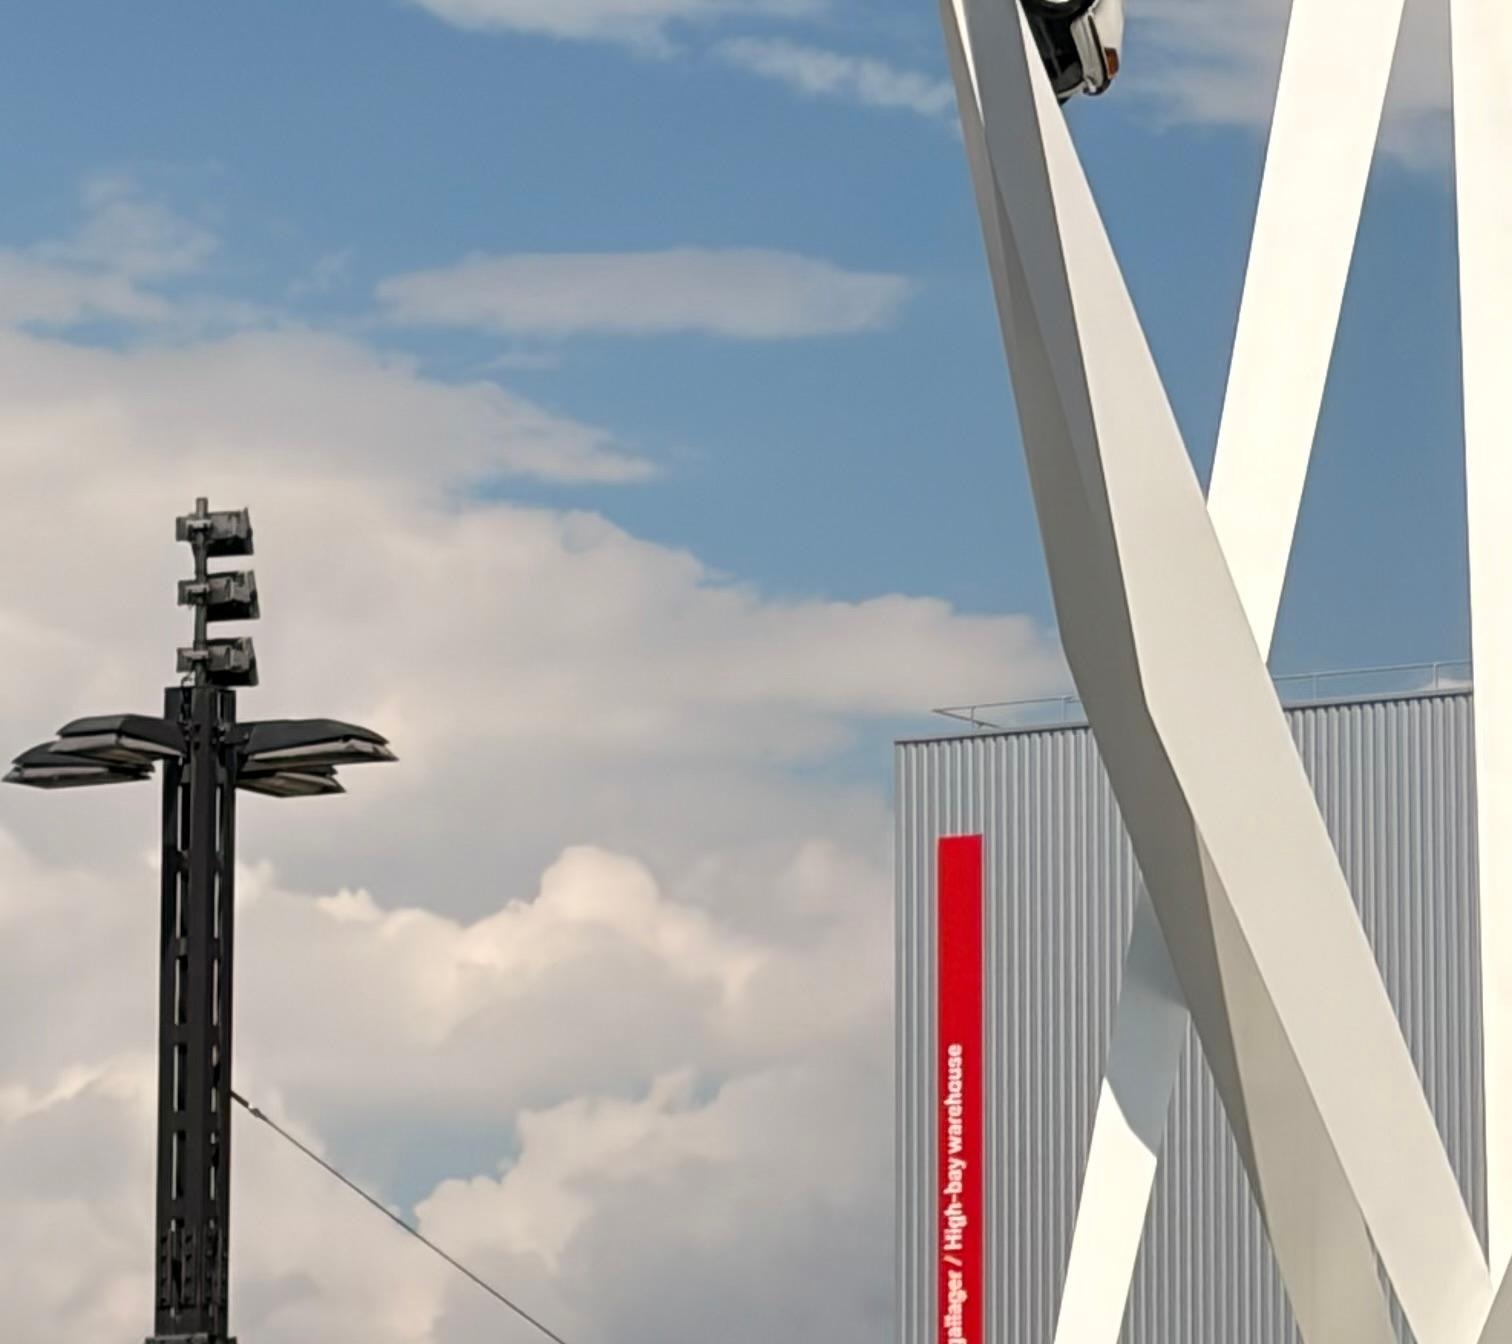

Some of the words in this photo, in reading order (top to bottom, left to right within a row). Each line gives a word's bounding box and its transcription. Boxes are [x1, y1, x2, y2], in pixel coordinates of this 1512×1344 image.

[943, 1043, 963, 1155] warehouse
[942, 1157, 967, 1251] High-bay
[942, 1255, 963, 1267] /
